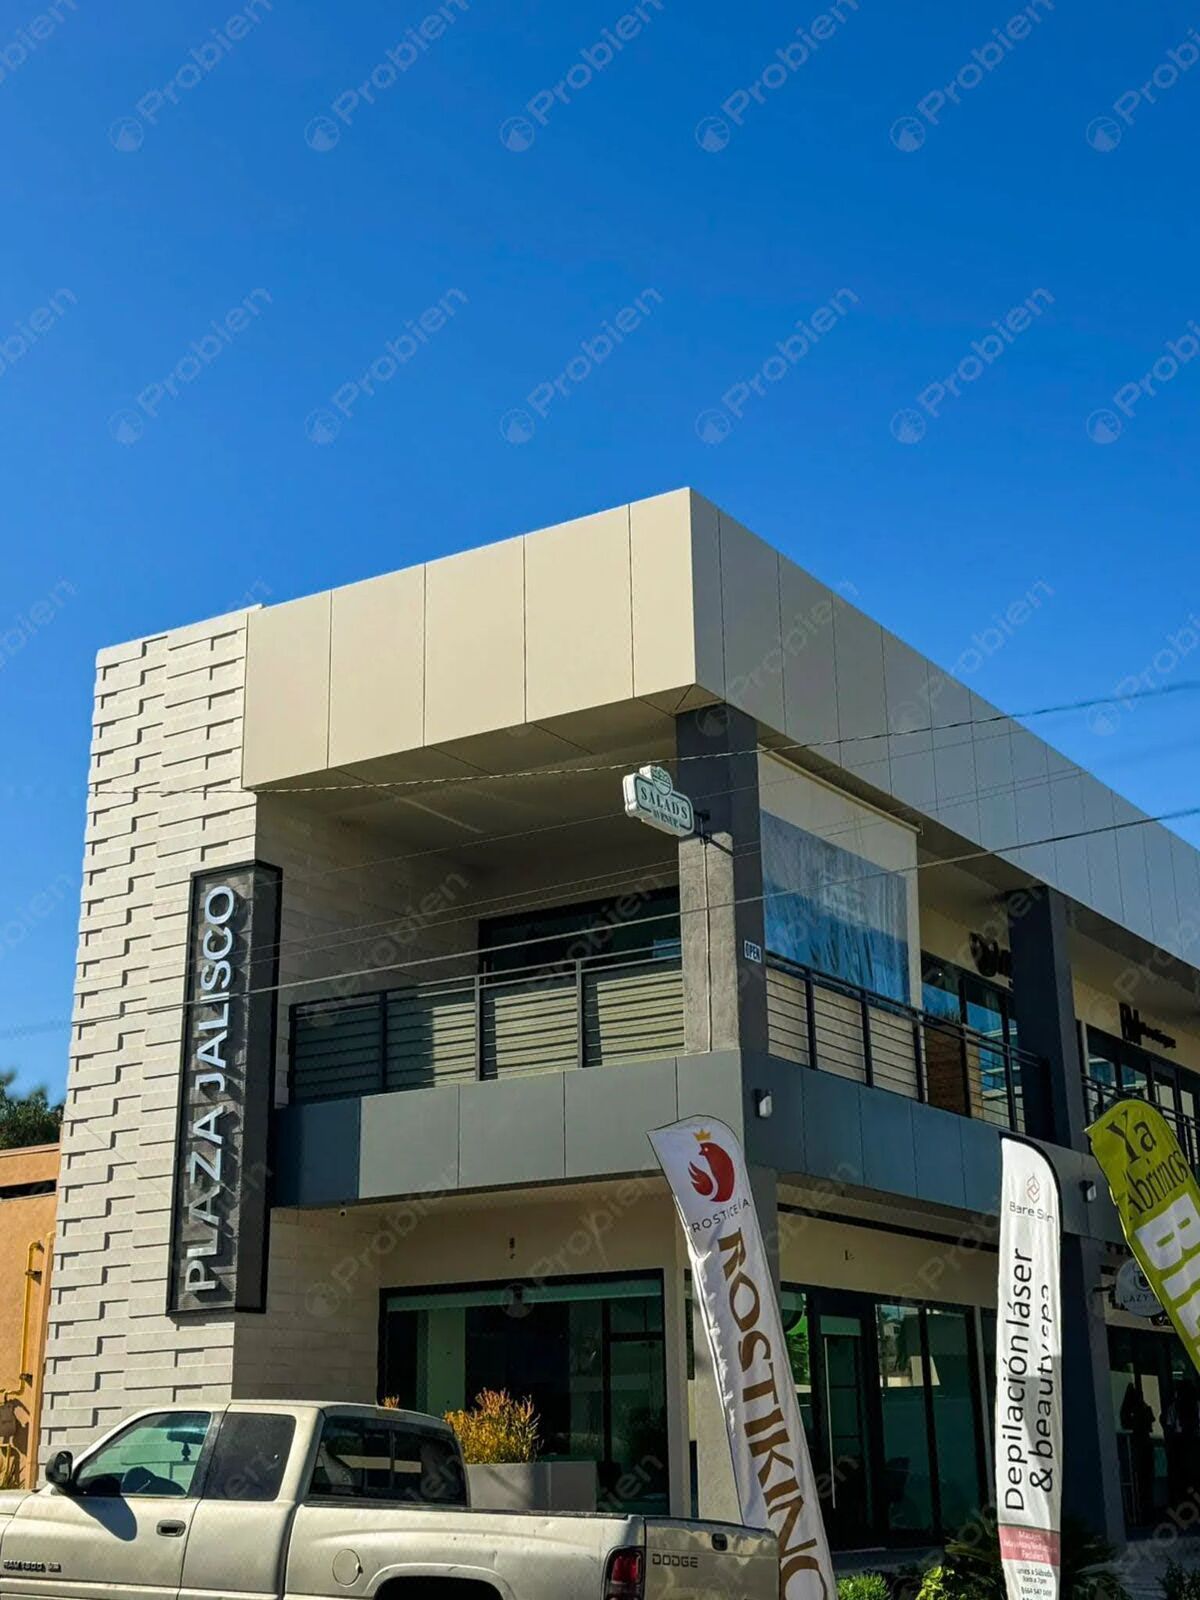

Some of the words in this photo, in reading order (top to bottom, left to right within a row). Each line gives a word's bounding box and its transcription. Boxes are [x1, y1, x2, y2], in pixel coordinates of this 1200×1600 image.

[640, 786, 688, 819] SALADS
[745, 942, 761, 962] OPEN
[195, 884, 236, 1093] JALISCO
[1106, 1109, 1157, 1164] Ya
[184, 1105, 226, 1293] PLAZA
[1009, 1201, 1034, 1217] Bare
[1005, 1248, 1033, 1328] láser
[1002, 1331, 1029, 1511] Depilación
[1029, 1468, 1053, 1493] &
[652, 1553, 698, 1568] DODGE
